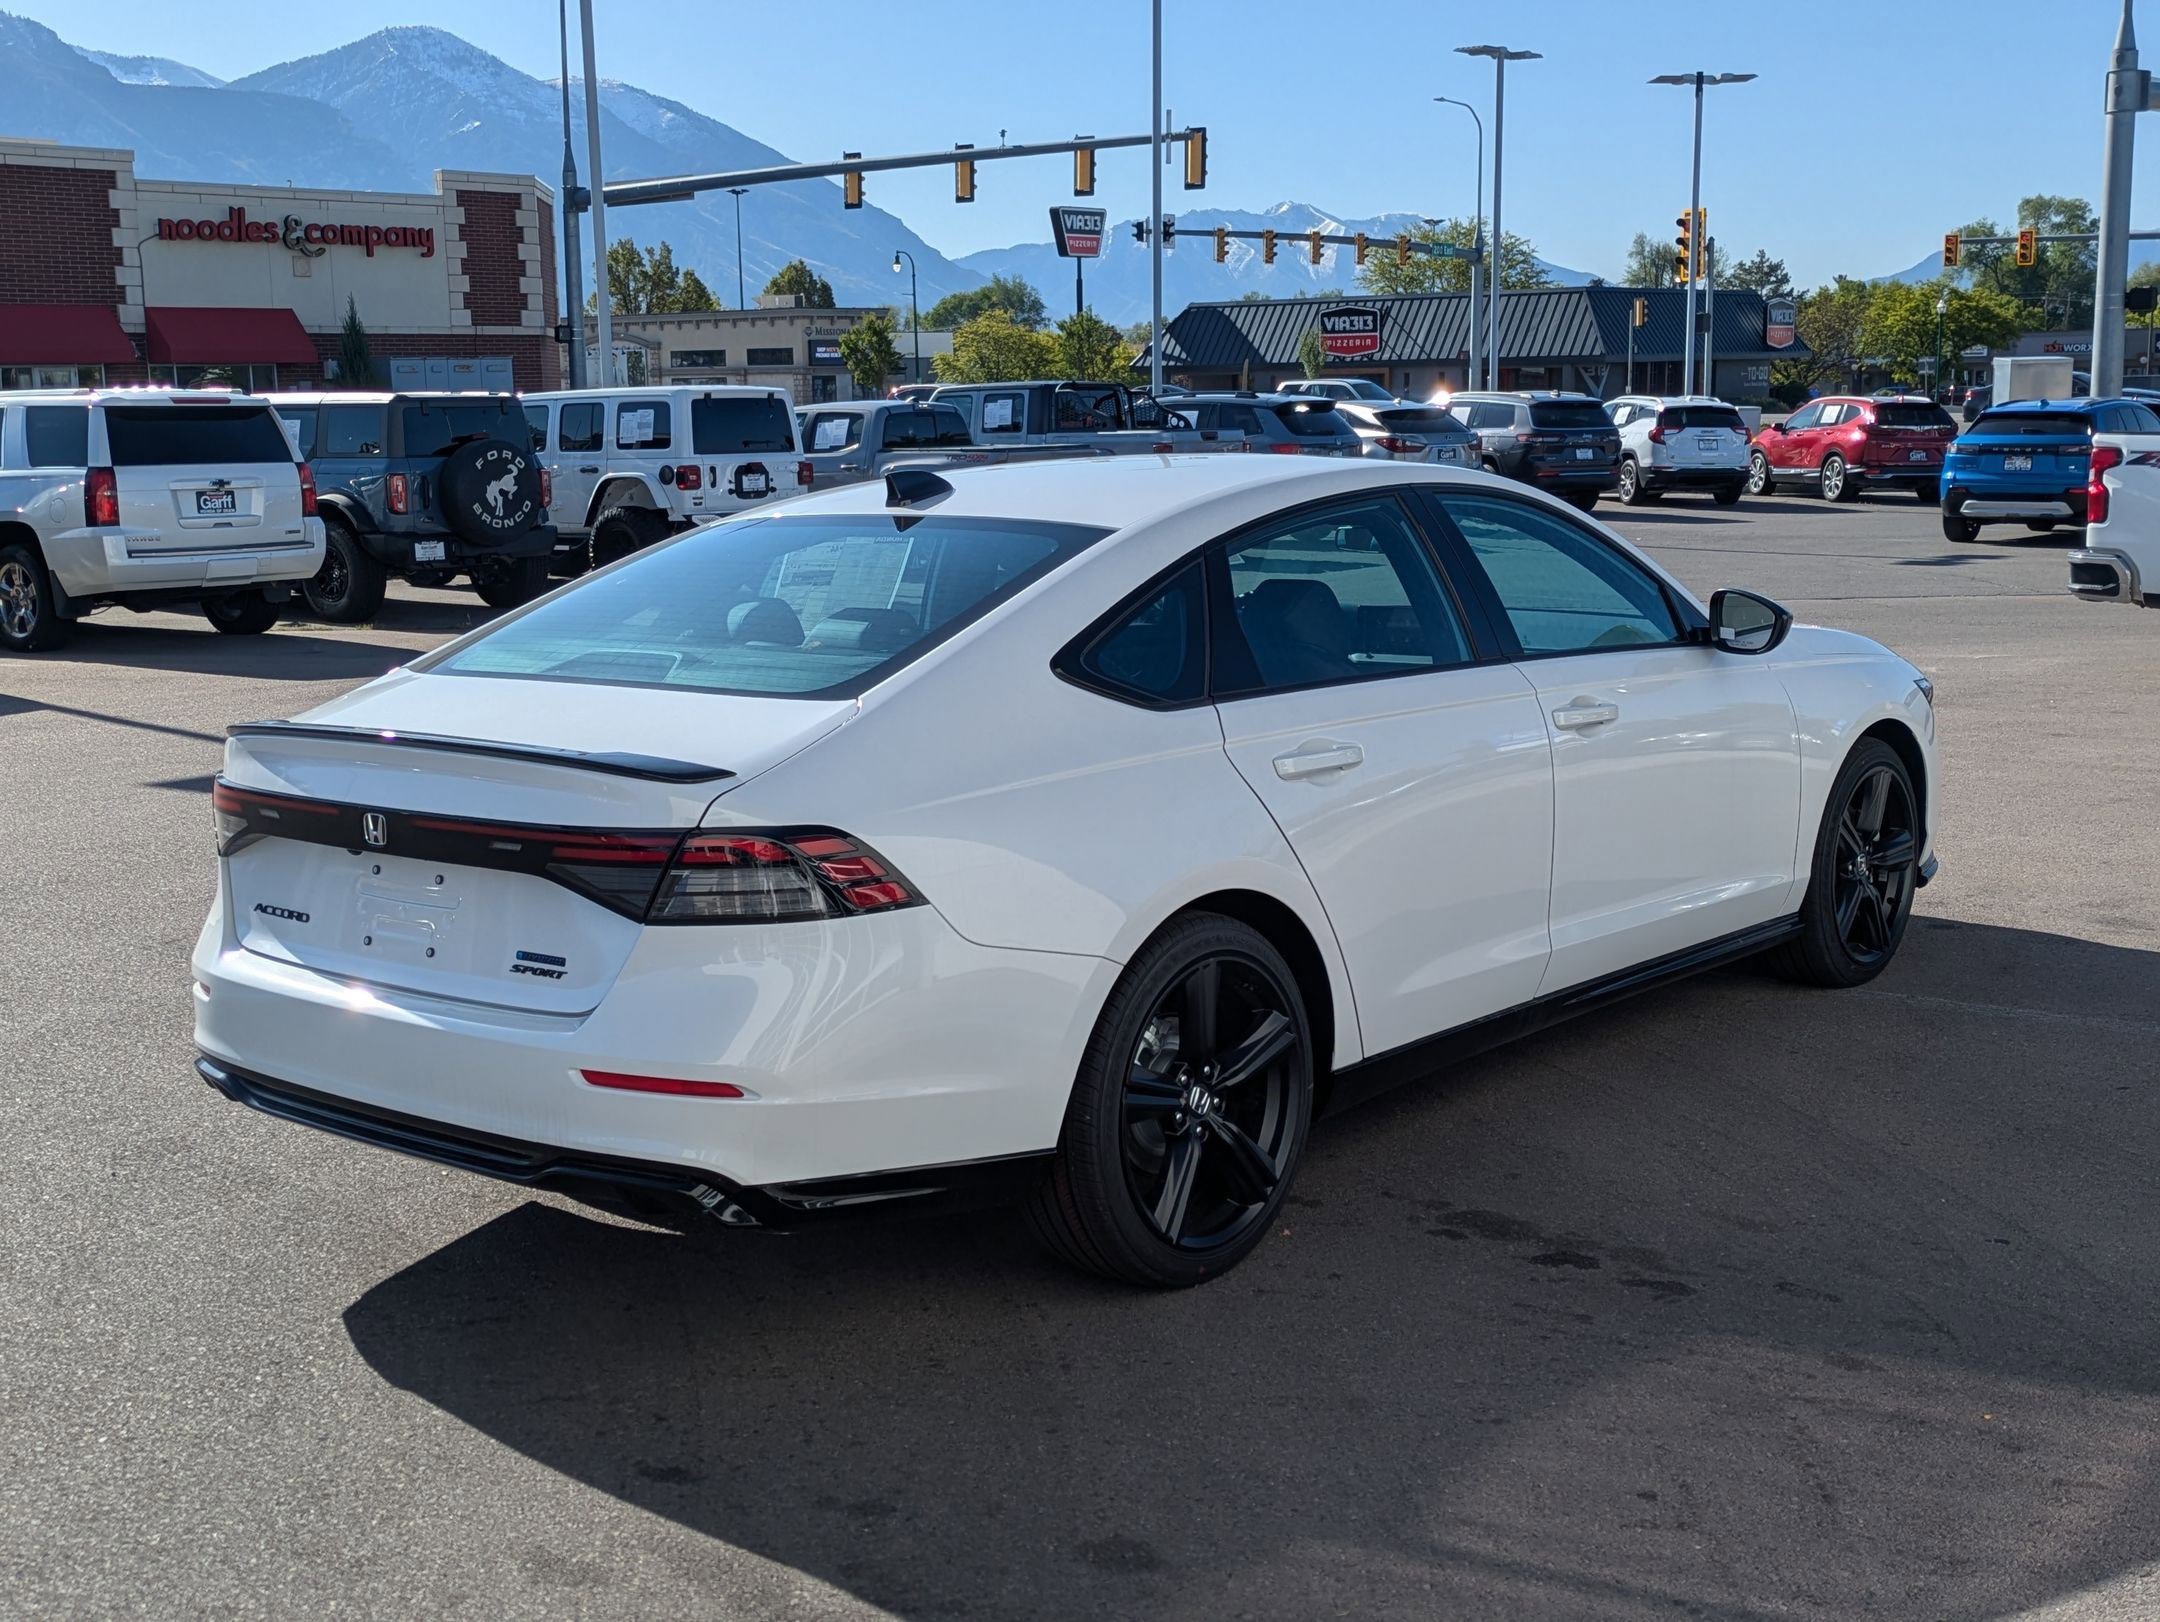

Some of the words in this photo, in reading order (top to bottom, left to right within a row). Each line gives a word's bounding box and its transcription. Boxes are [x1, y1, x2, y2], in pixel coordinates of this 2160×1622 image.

[158, 206, 279, 243] noodles
[283, 214, 326, 257] &
[304, 223, 435, 257] company
[1069, 239, 1097, 248] PIZZERIA
[1327, 339, 1372, 347] PIZZERIA
[475, 450, 526, 470] FORD
[200, 495, 233, 509] Garff
[472, 500, 532, 528] BRONCO
[253, 903, 310, 923] ACCORD
[509, 964, 568, 980] SPORT
